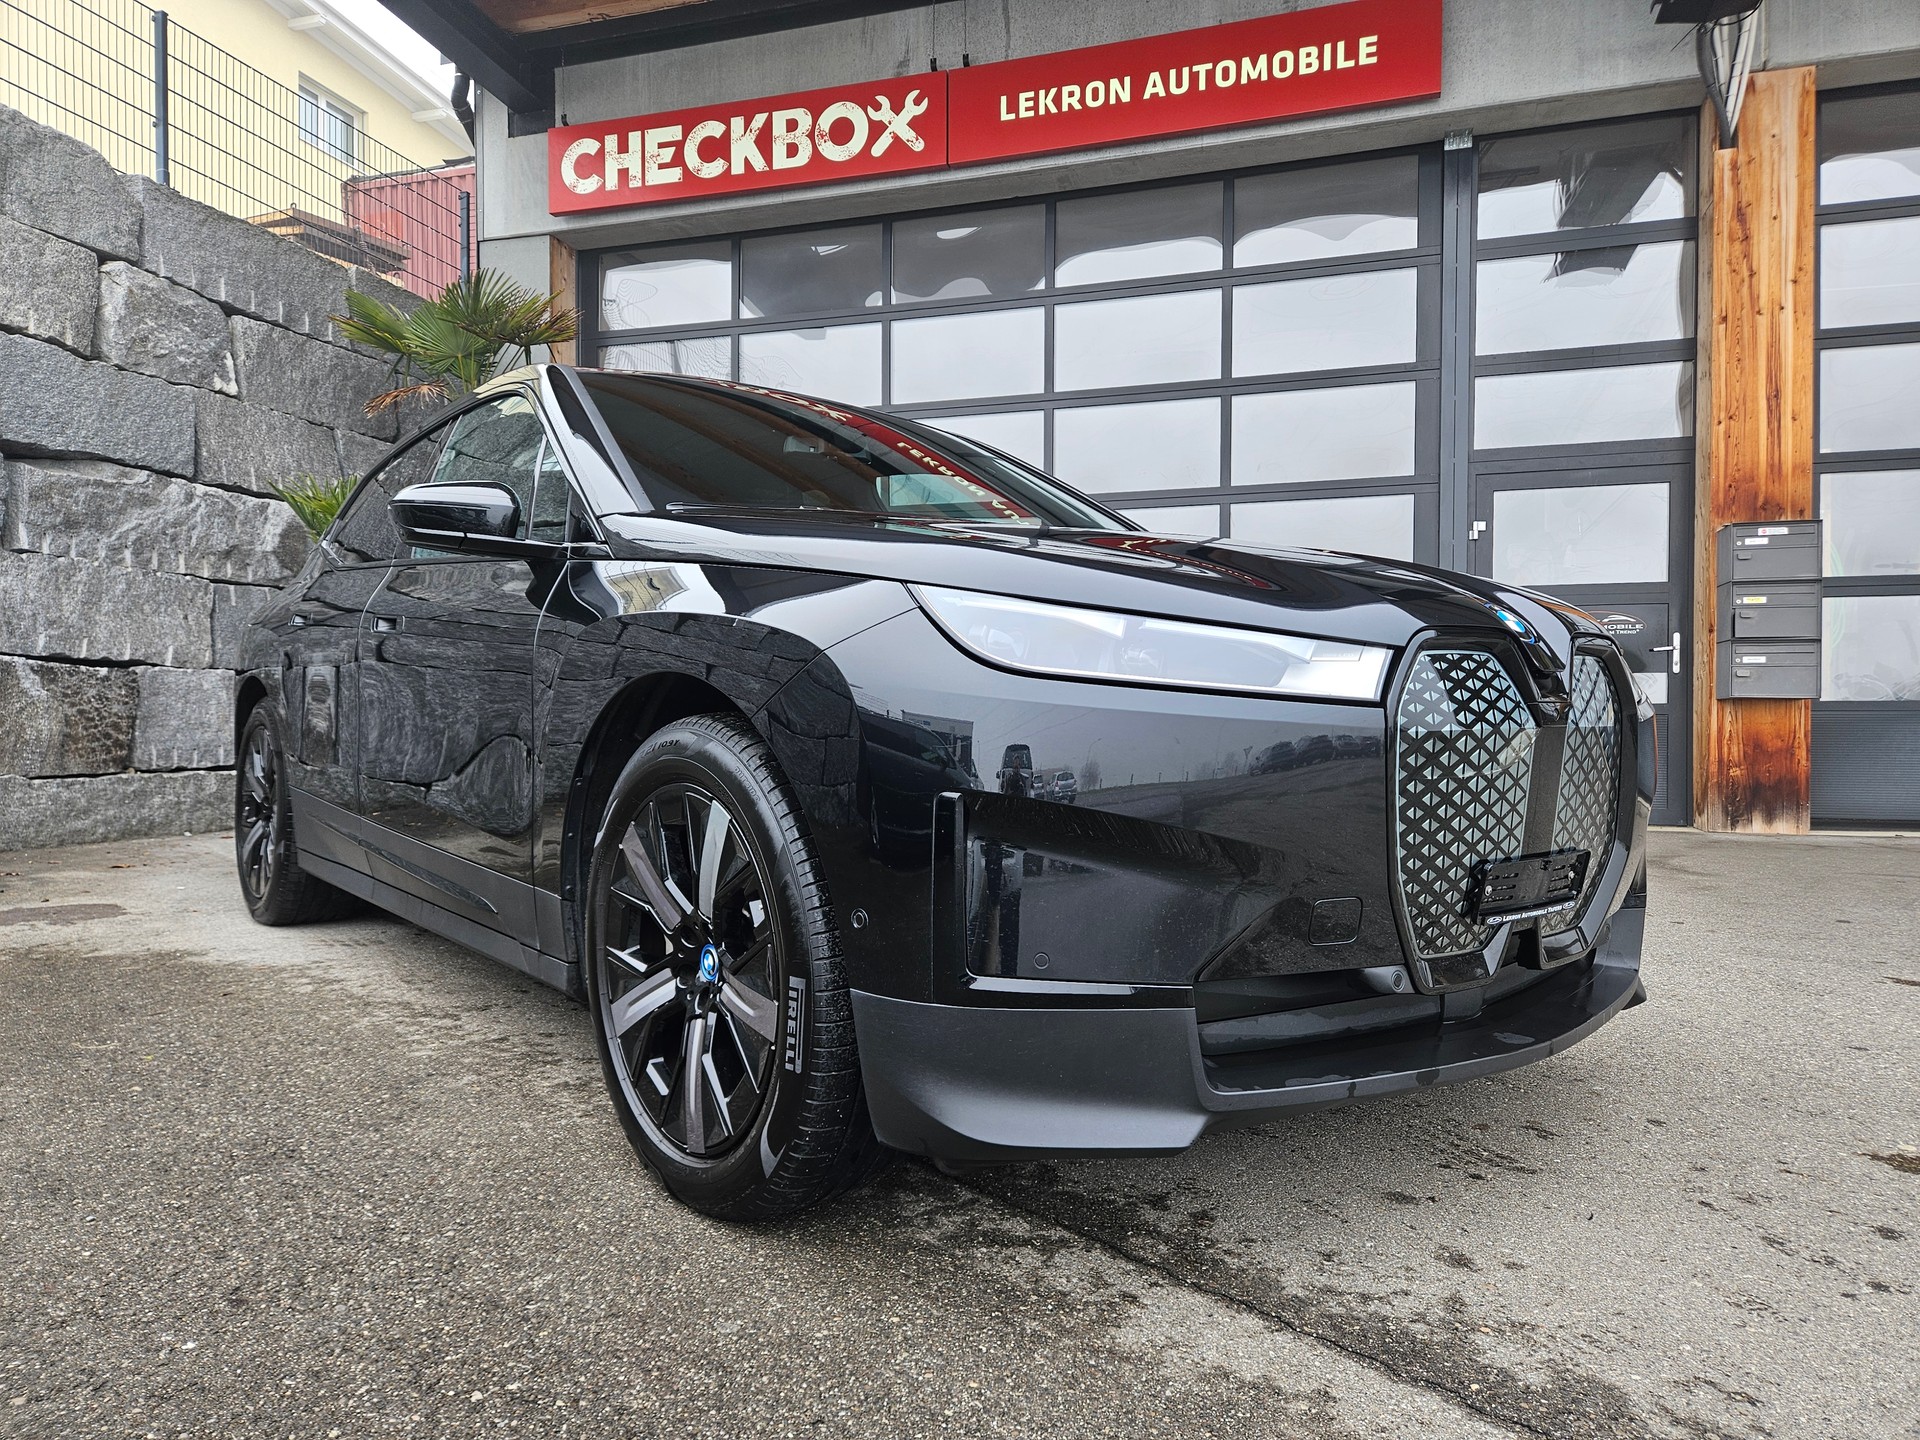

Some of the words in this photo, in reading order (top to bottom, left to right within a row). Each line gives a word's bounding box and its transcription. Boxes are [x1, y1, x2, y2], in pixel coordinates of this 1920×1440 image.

[1000, 76, 1131, 121] LEKRON
[1143, 35, 1378, 100] AUTOMOBILE
[561, 89, 928, 194] CHECKBOX
[785, 975, 806, 1074] PIRELLI
